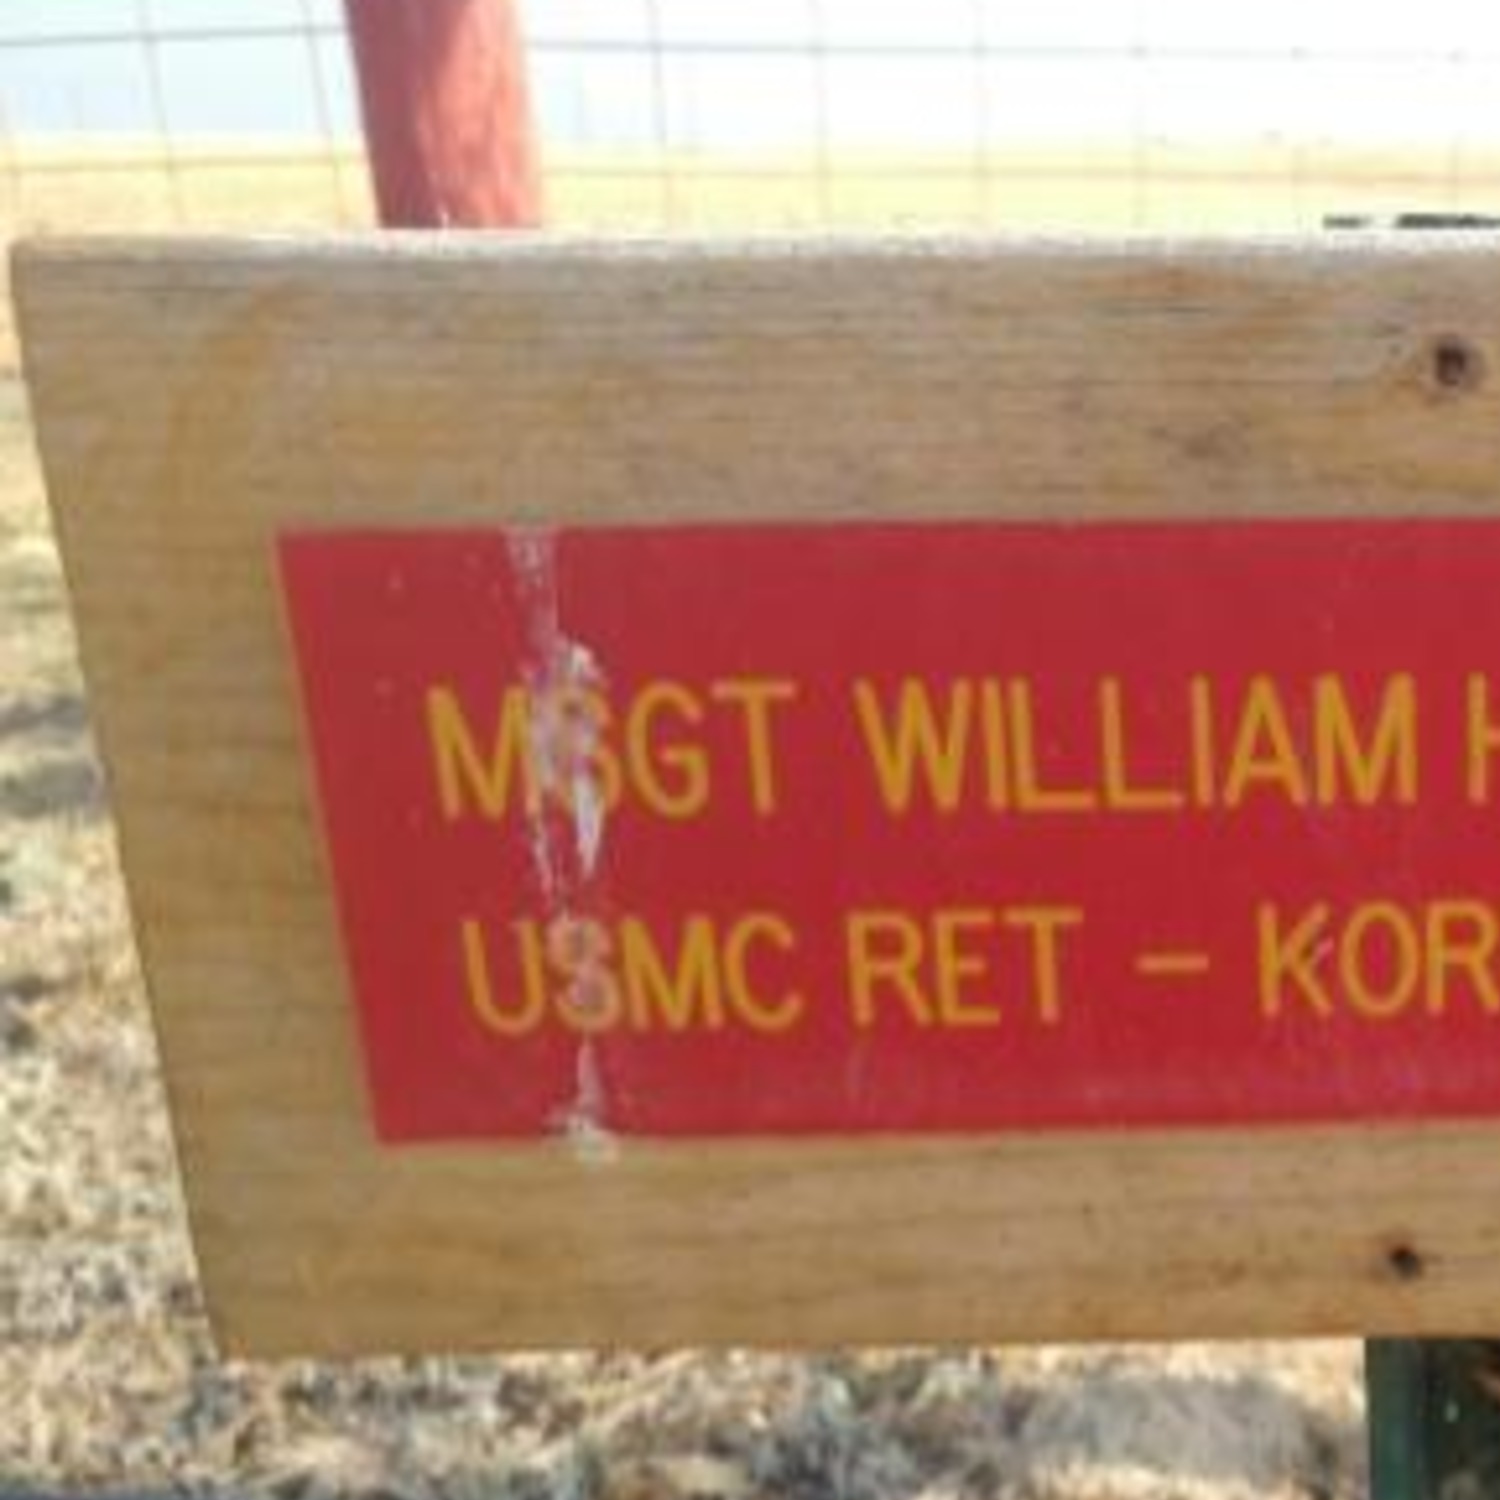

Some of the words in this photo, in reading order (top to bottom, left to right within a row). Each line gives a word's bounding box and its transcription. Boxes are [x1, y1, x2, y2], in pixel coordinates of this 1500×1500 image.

[852, 670, 1421, 814] WILLIAM
[459, 911, 804, 1038] USMC
[843, 904, 1083, 1028] RET
